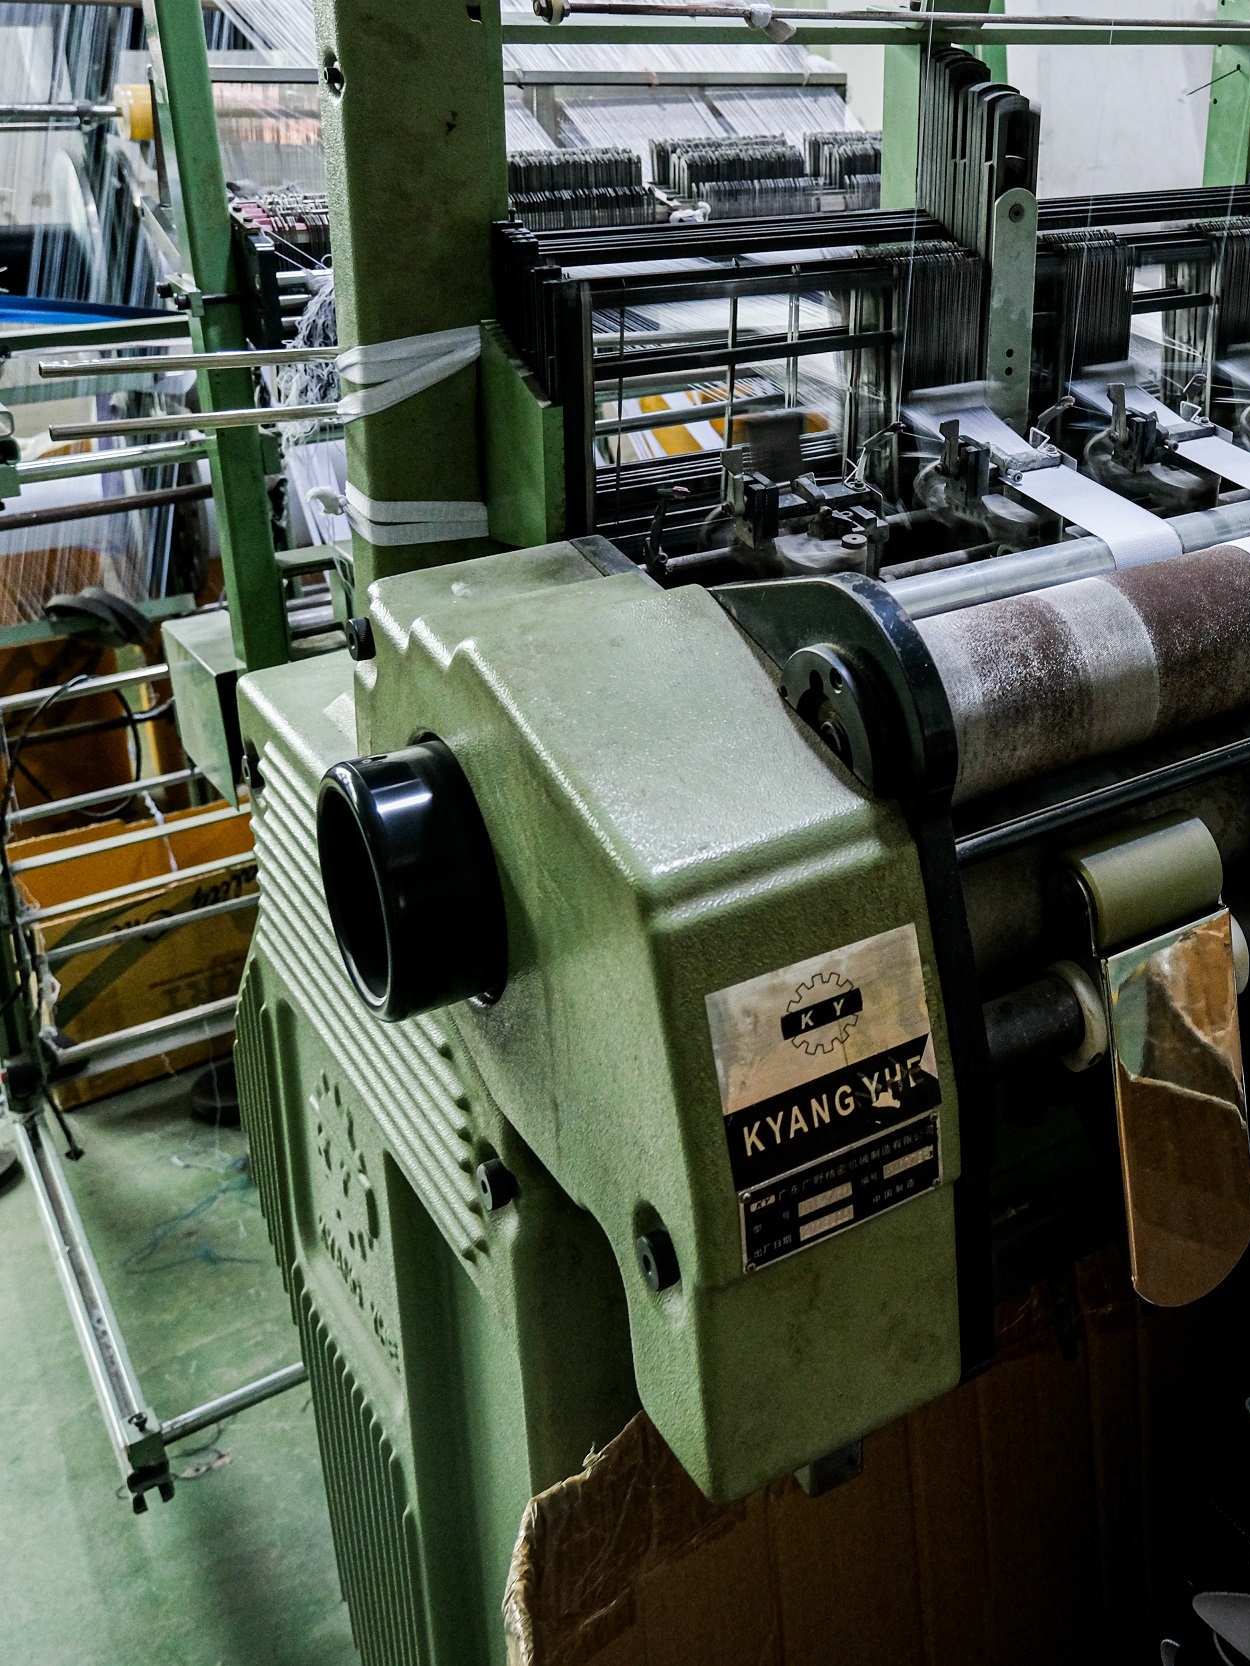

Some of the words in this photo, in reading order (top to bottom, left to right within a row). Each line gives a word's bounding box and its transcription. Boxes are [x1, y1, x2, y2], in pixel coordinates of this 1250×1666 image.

[743, 1085, 855, 1157] KYANG
[752, 1233, 793, 1260] 出厂日期
